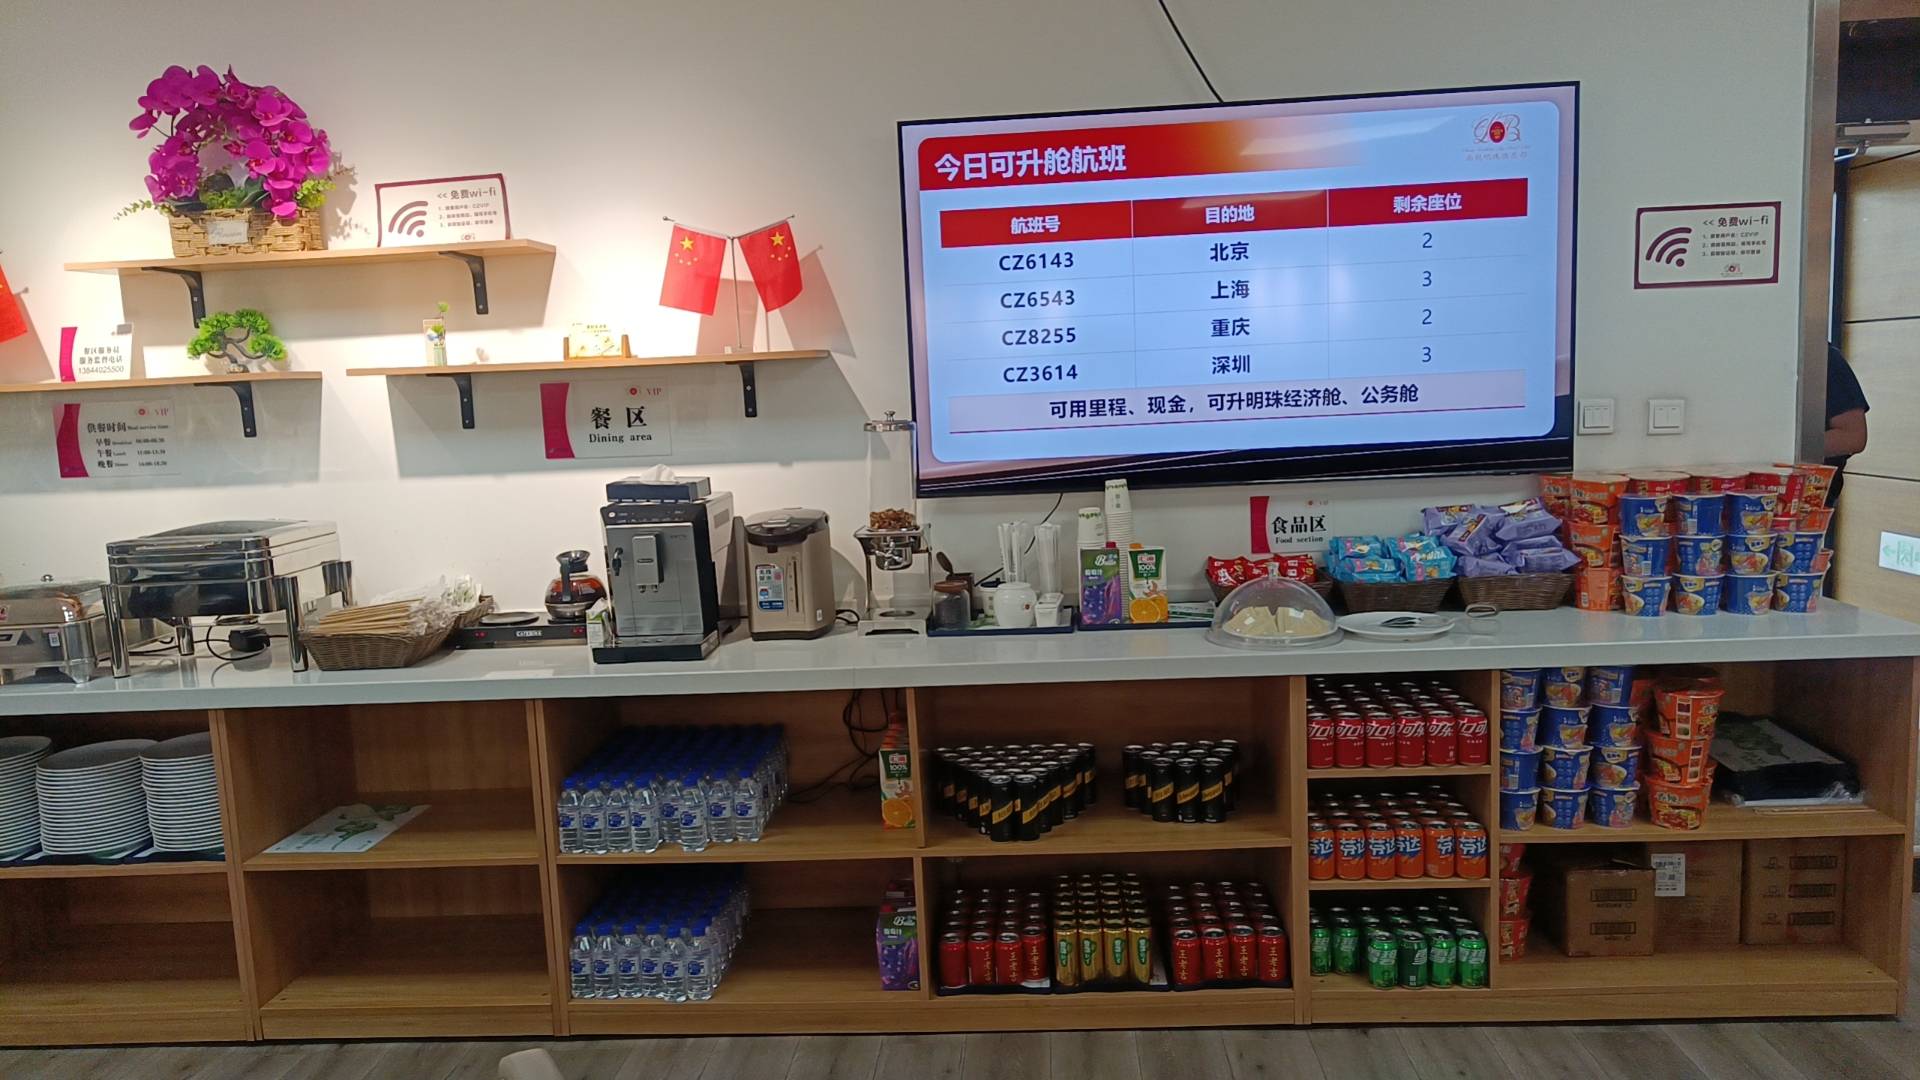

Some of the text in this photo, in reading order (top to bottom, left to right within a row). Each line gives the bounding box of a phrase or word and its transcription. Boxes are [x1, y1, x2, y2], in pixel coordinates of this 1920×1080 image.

[934, 144, 1126, 182] 今日可升舱航班
[1393, 192, 1462, 214] 剩余座位
[1010, 214, 1060, 235] 航班号
[1204, 204, 1255, 225] 目的地
[1422, 232, 1432, 249] 2
[999, 252, 1074, 271] CZ6143
[1209, 241, 1249, 262] 北京
[1422, 270, 1432, 287] 3
[1000, 289, 1076, 309] CZ6543
[1210, 279, 1250, 300] 上海
[1422, 308, 1432, 325] 2
[1002, 327, 1077, 346] CZ8255
[1210, 317, 1250, 337] 重庆
[1211, 354, 1251, 375] 深圳
[1421, 346, 1431, 363] 3
[1003, 363, 1079, 383] CZ3614
[591, 406, 647, 429] 餐区
[589, 433, 652, 443] Dining area
[1272, 514, 1327, 534] 食品区
